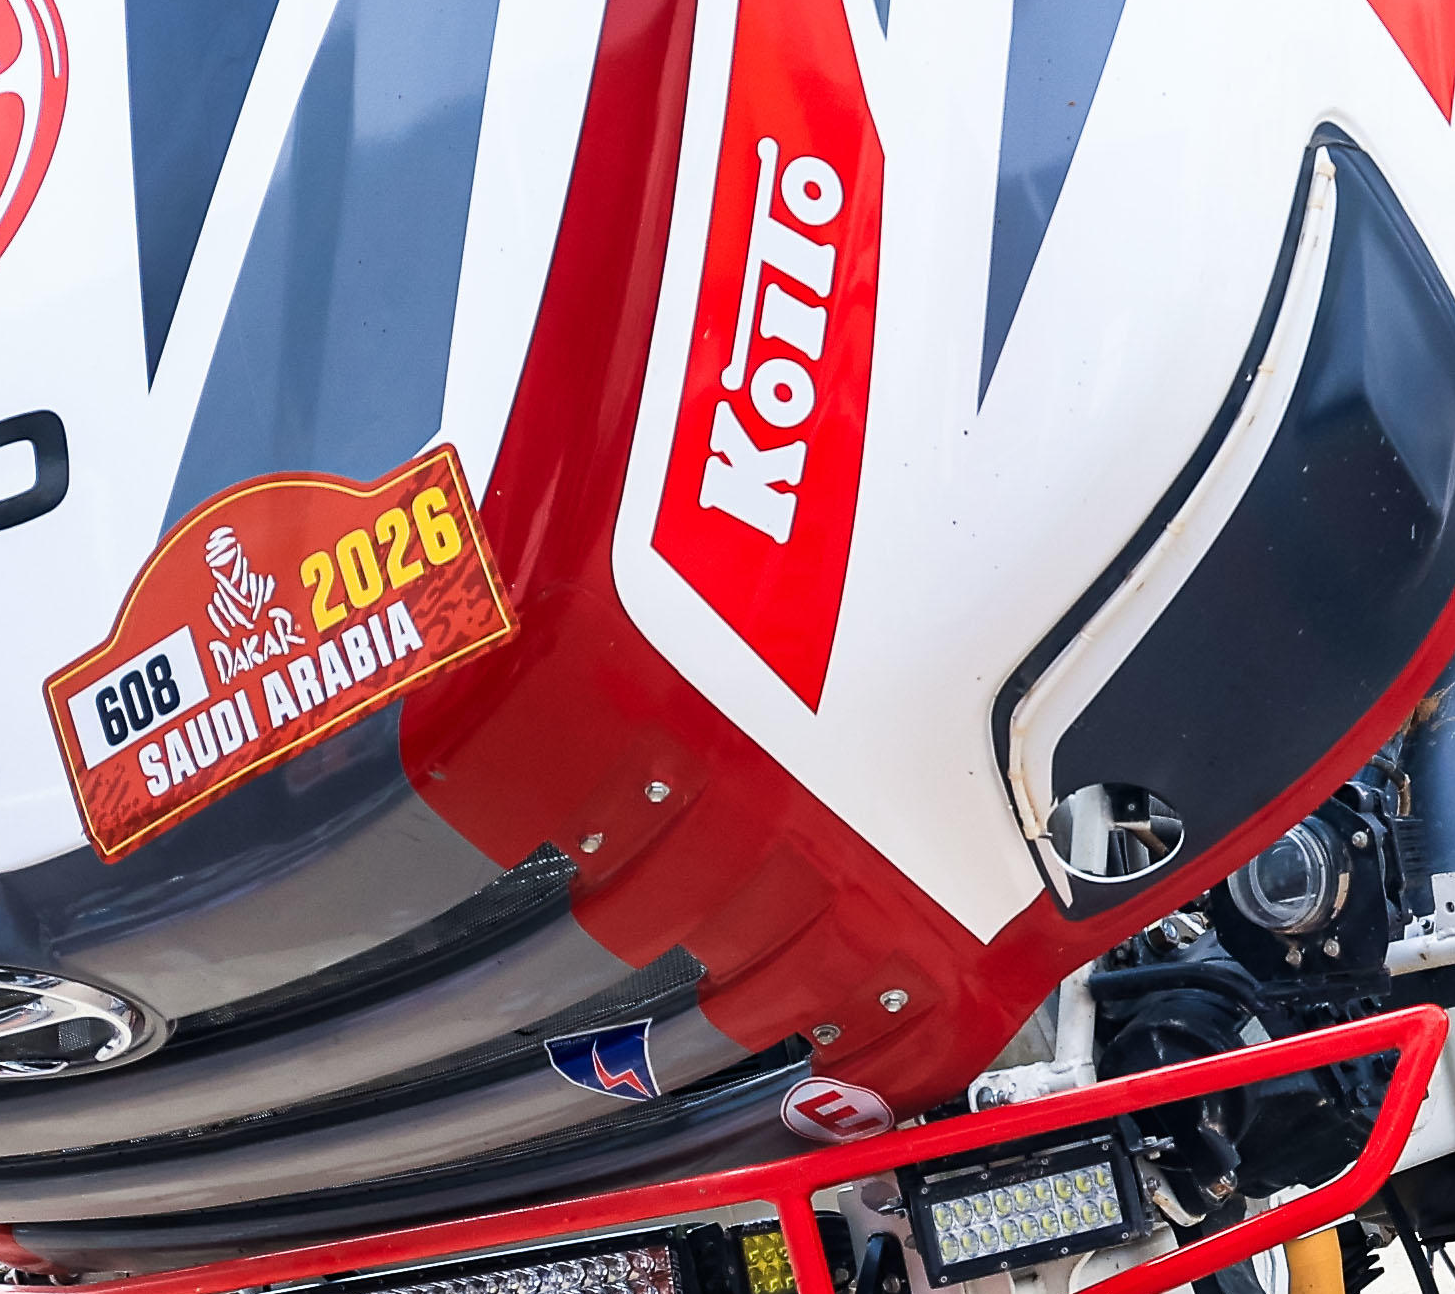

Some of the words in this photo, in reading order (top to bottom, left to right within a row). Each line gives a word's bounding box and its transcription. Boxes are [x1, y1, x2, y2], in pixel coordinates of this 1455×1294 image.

[299, 486, 464, 634] 2026
[94, 654, 181, 748] 608
[138, 687, 259, 798] SAUDI
[263, 600, 425, 730] ARABIA
[208, 607, 306, 685] DAKAR
